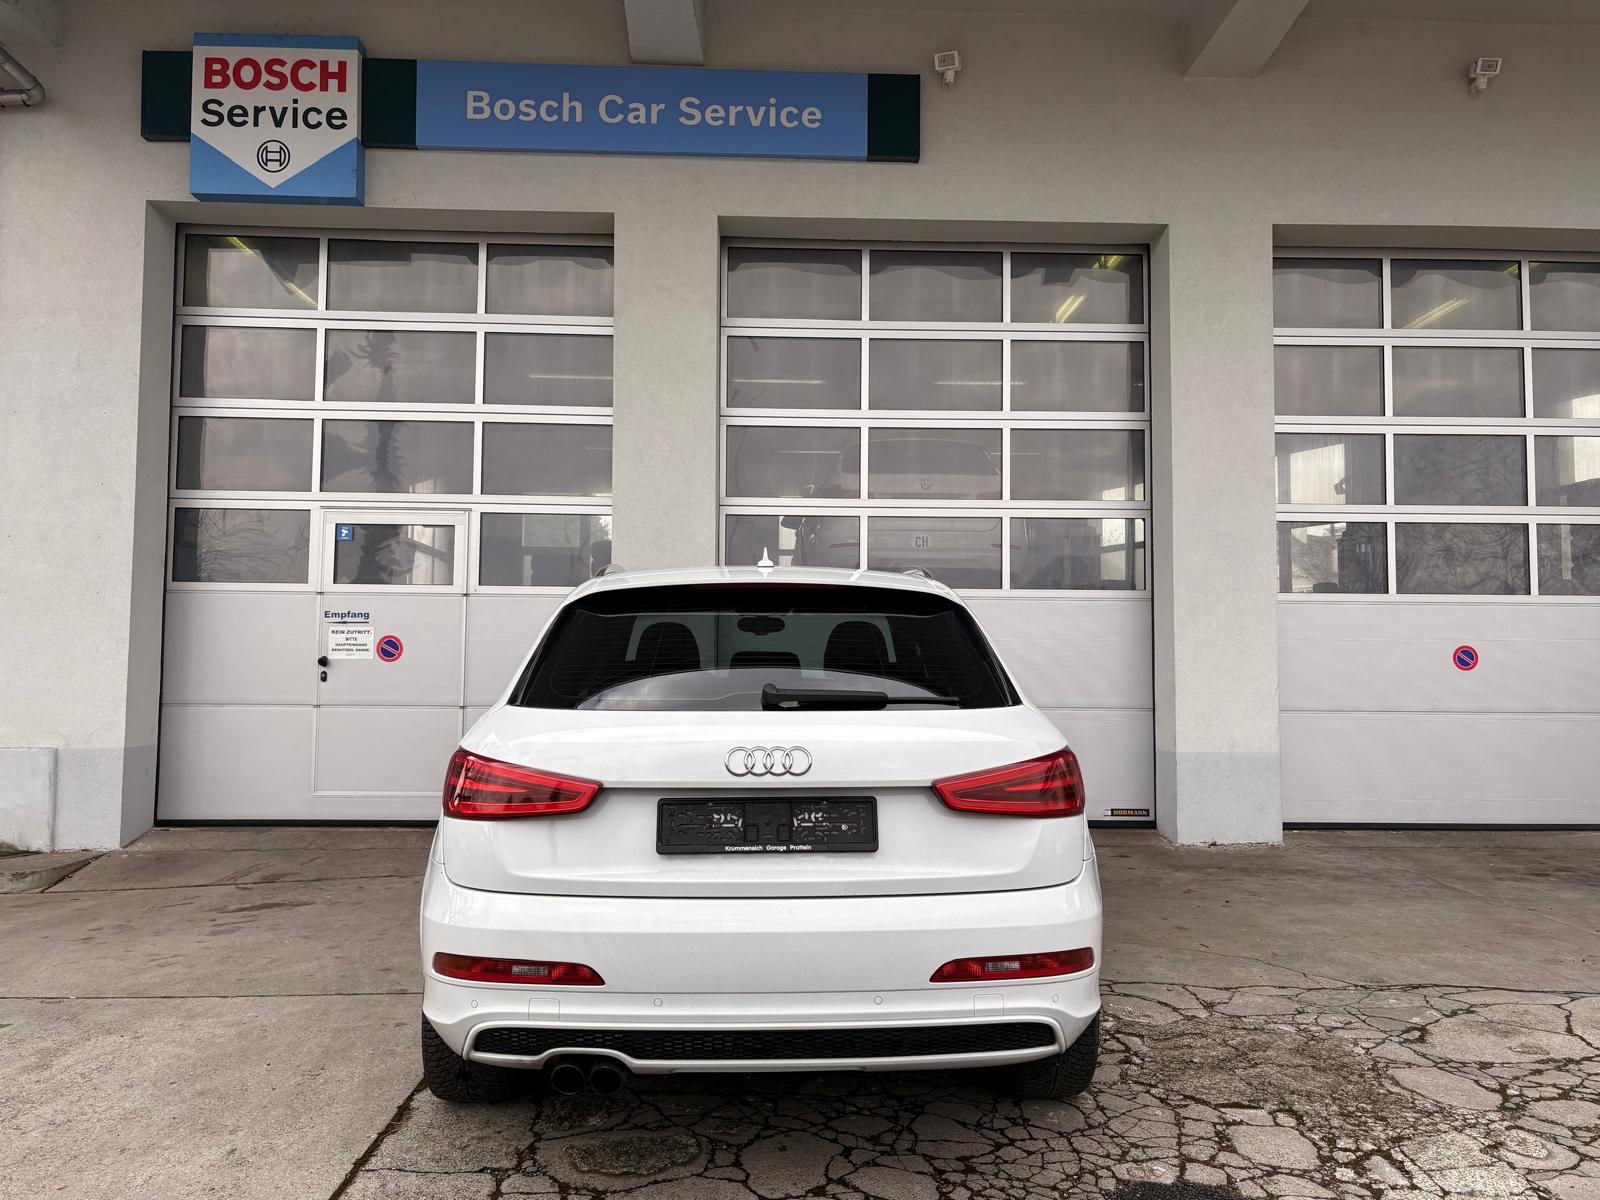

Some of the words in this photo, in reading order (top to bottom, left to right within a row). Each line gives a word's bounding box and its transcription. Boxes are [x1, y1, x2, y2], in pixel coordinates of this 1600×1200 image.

[203, 57, 348, 93] BOSCH
[200, 98, 348, 131] Service
[466, 90, 583, 123] Bosch
[598, 94, 665, 125] Car
[678, 97, 823, 129] Service
[915, 536, 929, 548] CH
[324, 610, 370, 620] Empfang
